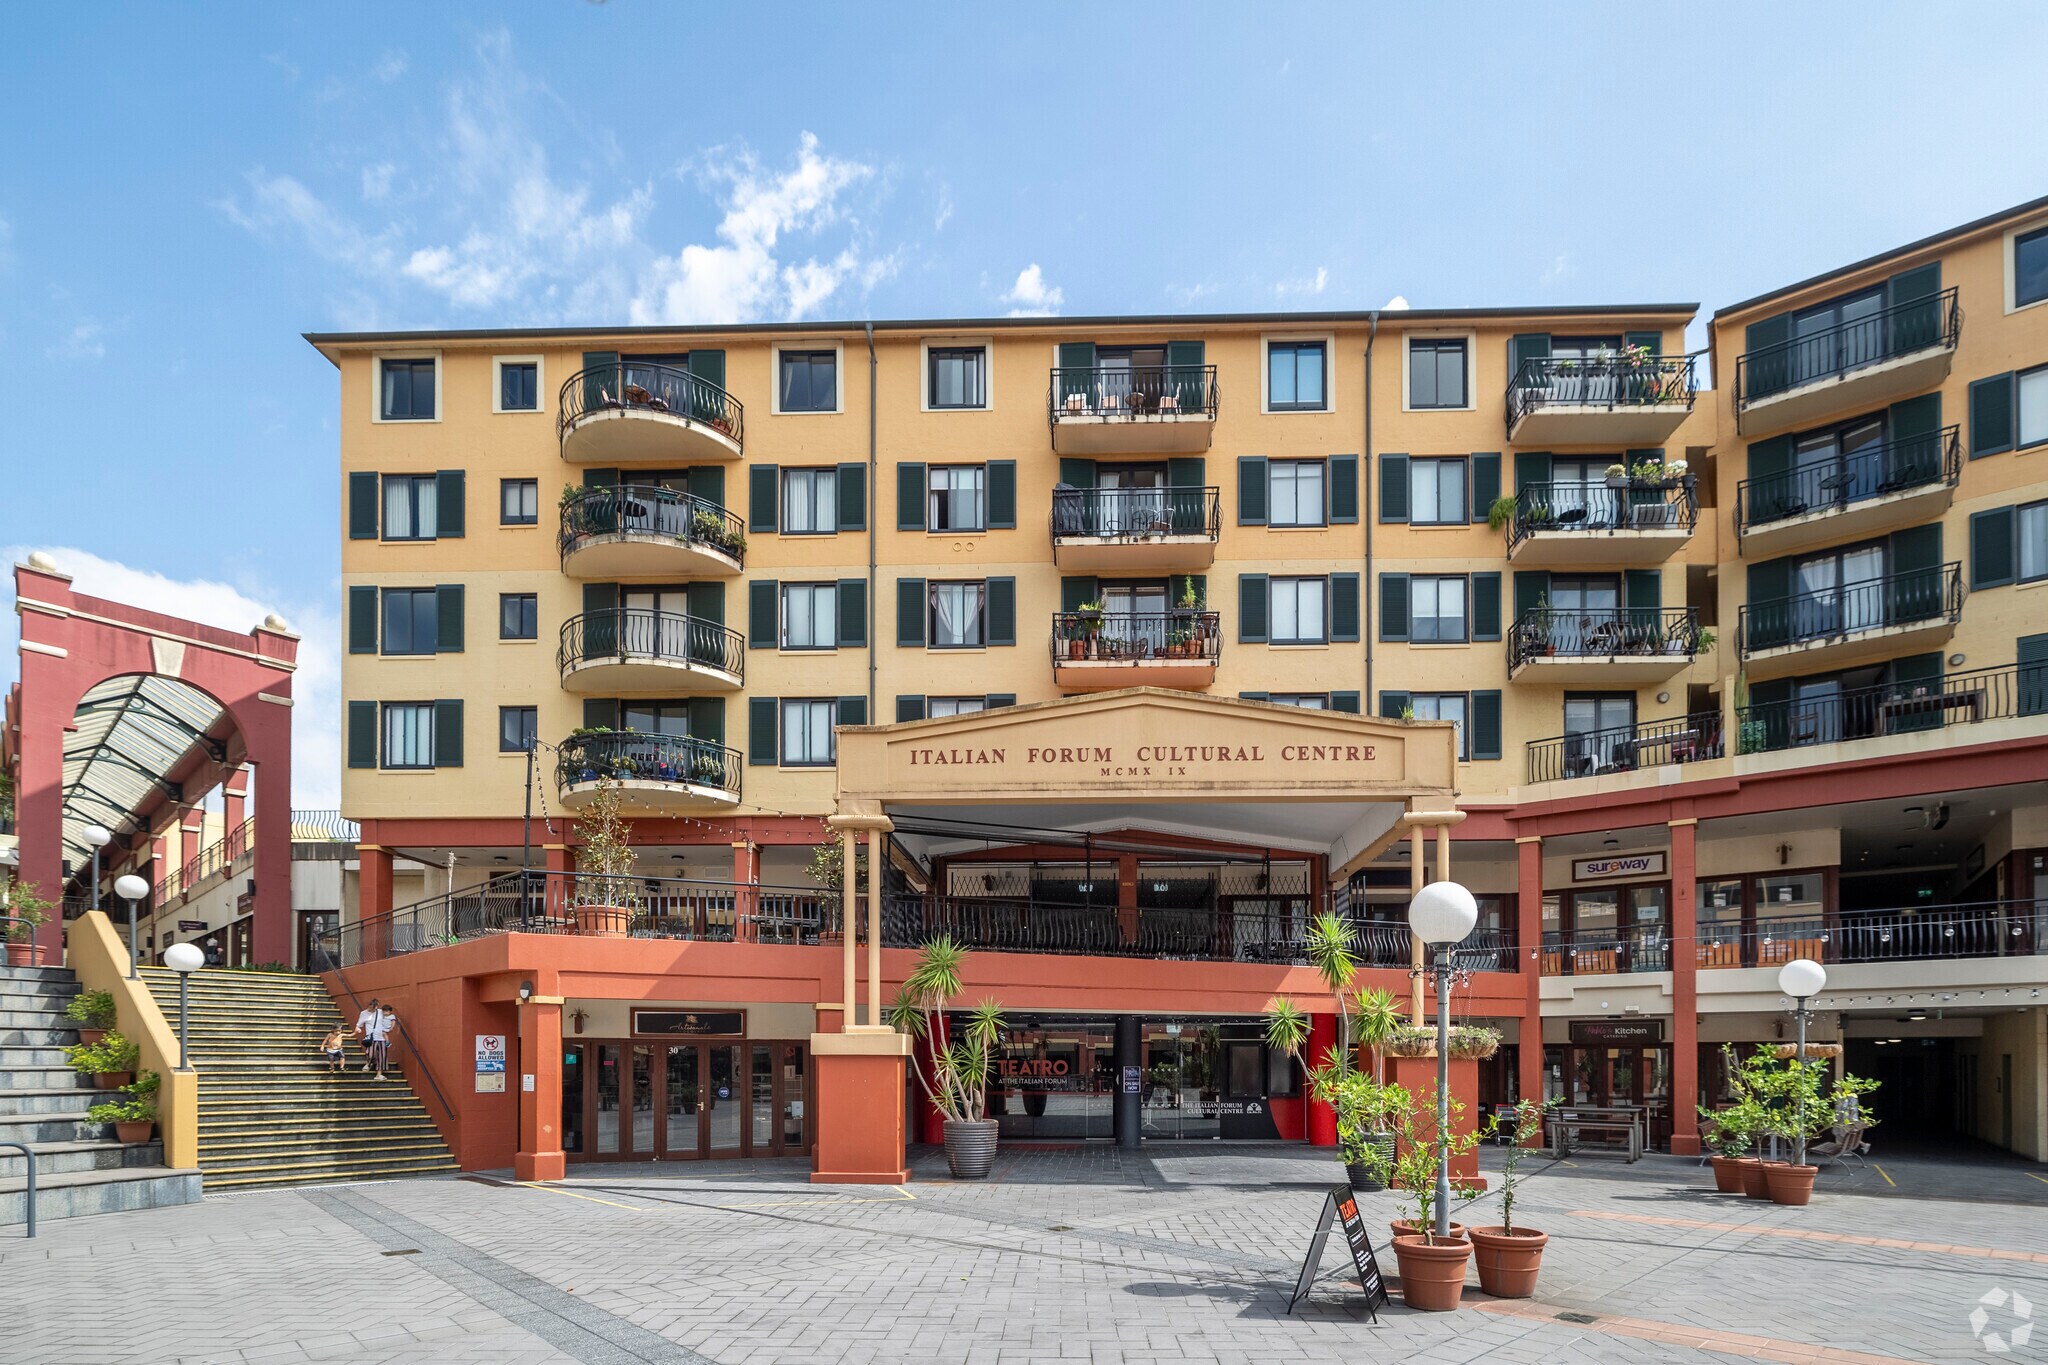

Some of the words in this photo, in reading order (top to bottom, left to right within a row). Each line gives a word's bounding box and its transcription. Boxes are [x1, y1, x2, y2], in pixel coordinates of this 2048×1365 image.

[910, 748, 1006, 765] ITALIAN
[1027, 747, 1112, 763] FORUM
[1136, 745, 1265, 762] CULTURAL
[1281, 745, 1376, 761] CENTRE
[1587, 858, 1650, 875] sureway
[1614, 1027, 1648, 1035] Kitchen
[668, 1046, 679, 1054] 30
[997, 1059, 1069, 1076] TEATRO
